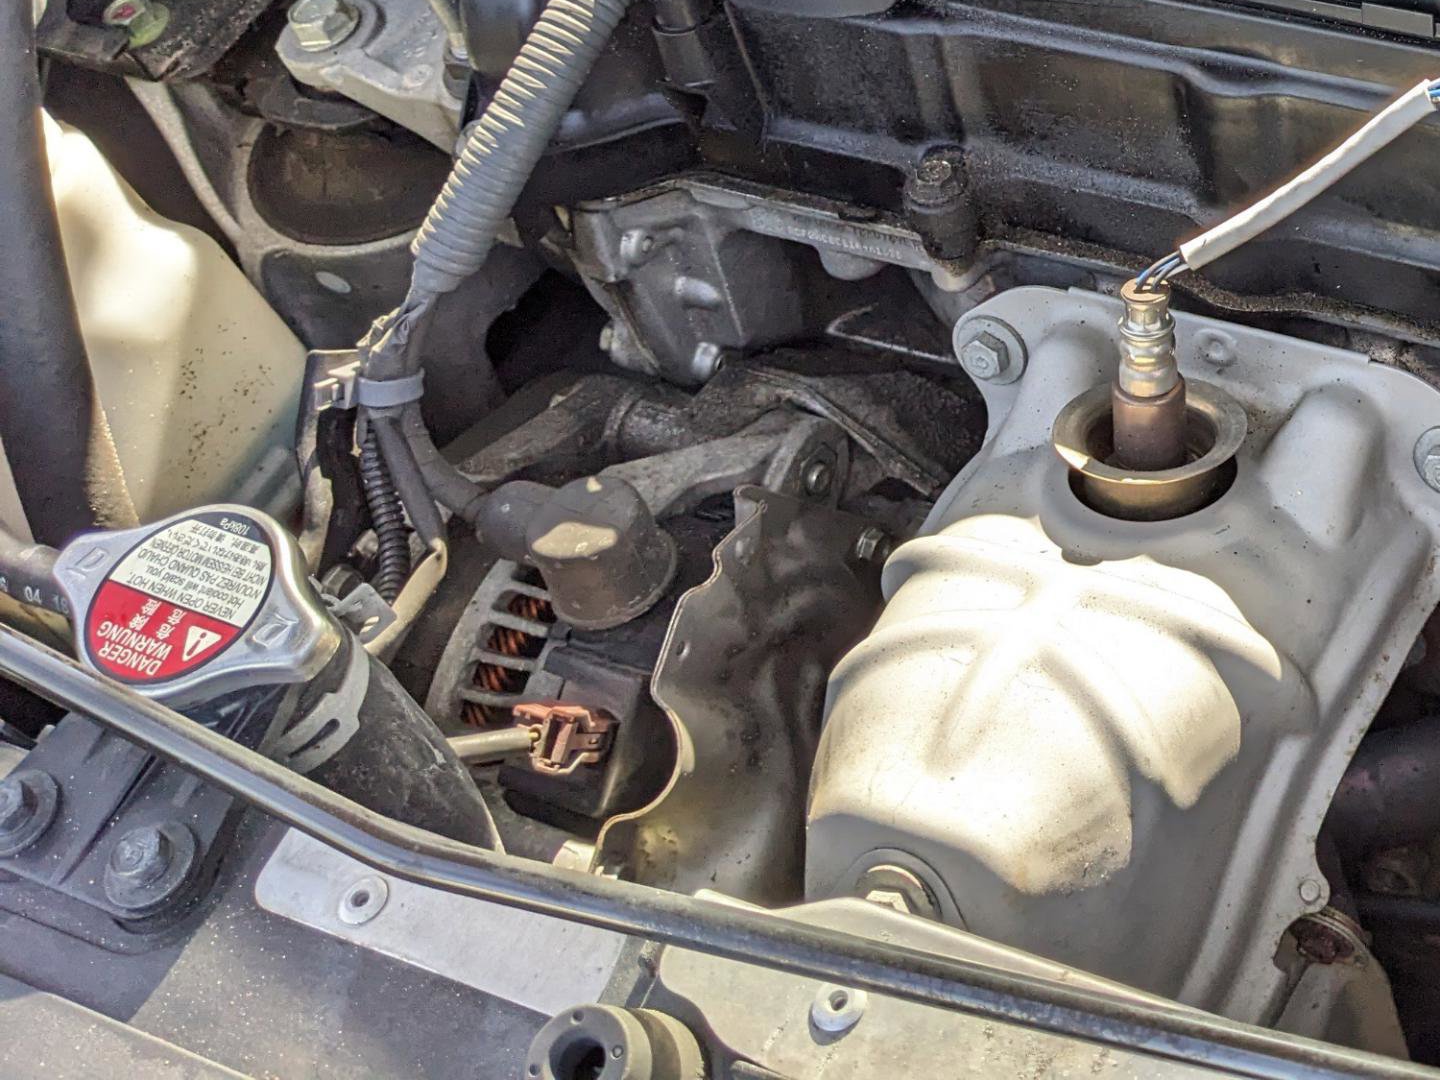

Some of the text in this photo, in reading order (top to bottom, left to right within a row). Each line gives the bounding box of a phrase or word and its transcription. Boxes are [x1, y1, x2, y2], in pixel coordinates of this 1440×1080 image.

[218, 517, 251, 535] 108kPa
[177, 548, 204, 563] MOTOR
[168, 560, 200, 576] QUAND
[229, 566, 245, 578] BEI
[161, 572, 185, 586] scald
[198, 570, 219, 583] PAS
[242, 571, 267, 586] NICHT
[182, 580, 200, 592] will
[197, 585, 228, 601] coolant
[25, 585, 42, 605] 04
[124, 572, 236, 618] NEVER OPEN WHEN HOT.
[225, 594, 245, 608] Hot
[94, 621, 174, 658] WARNUNG
[96, 641, 163, 674] DANGER
